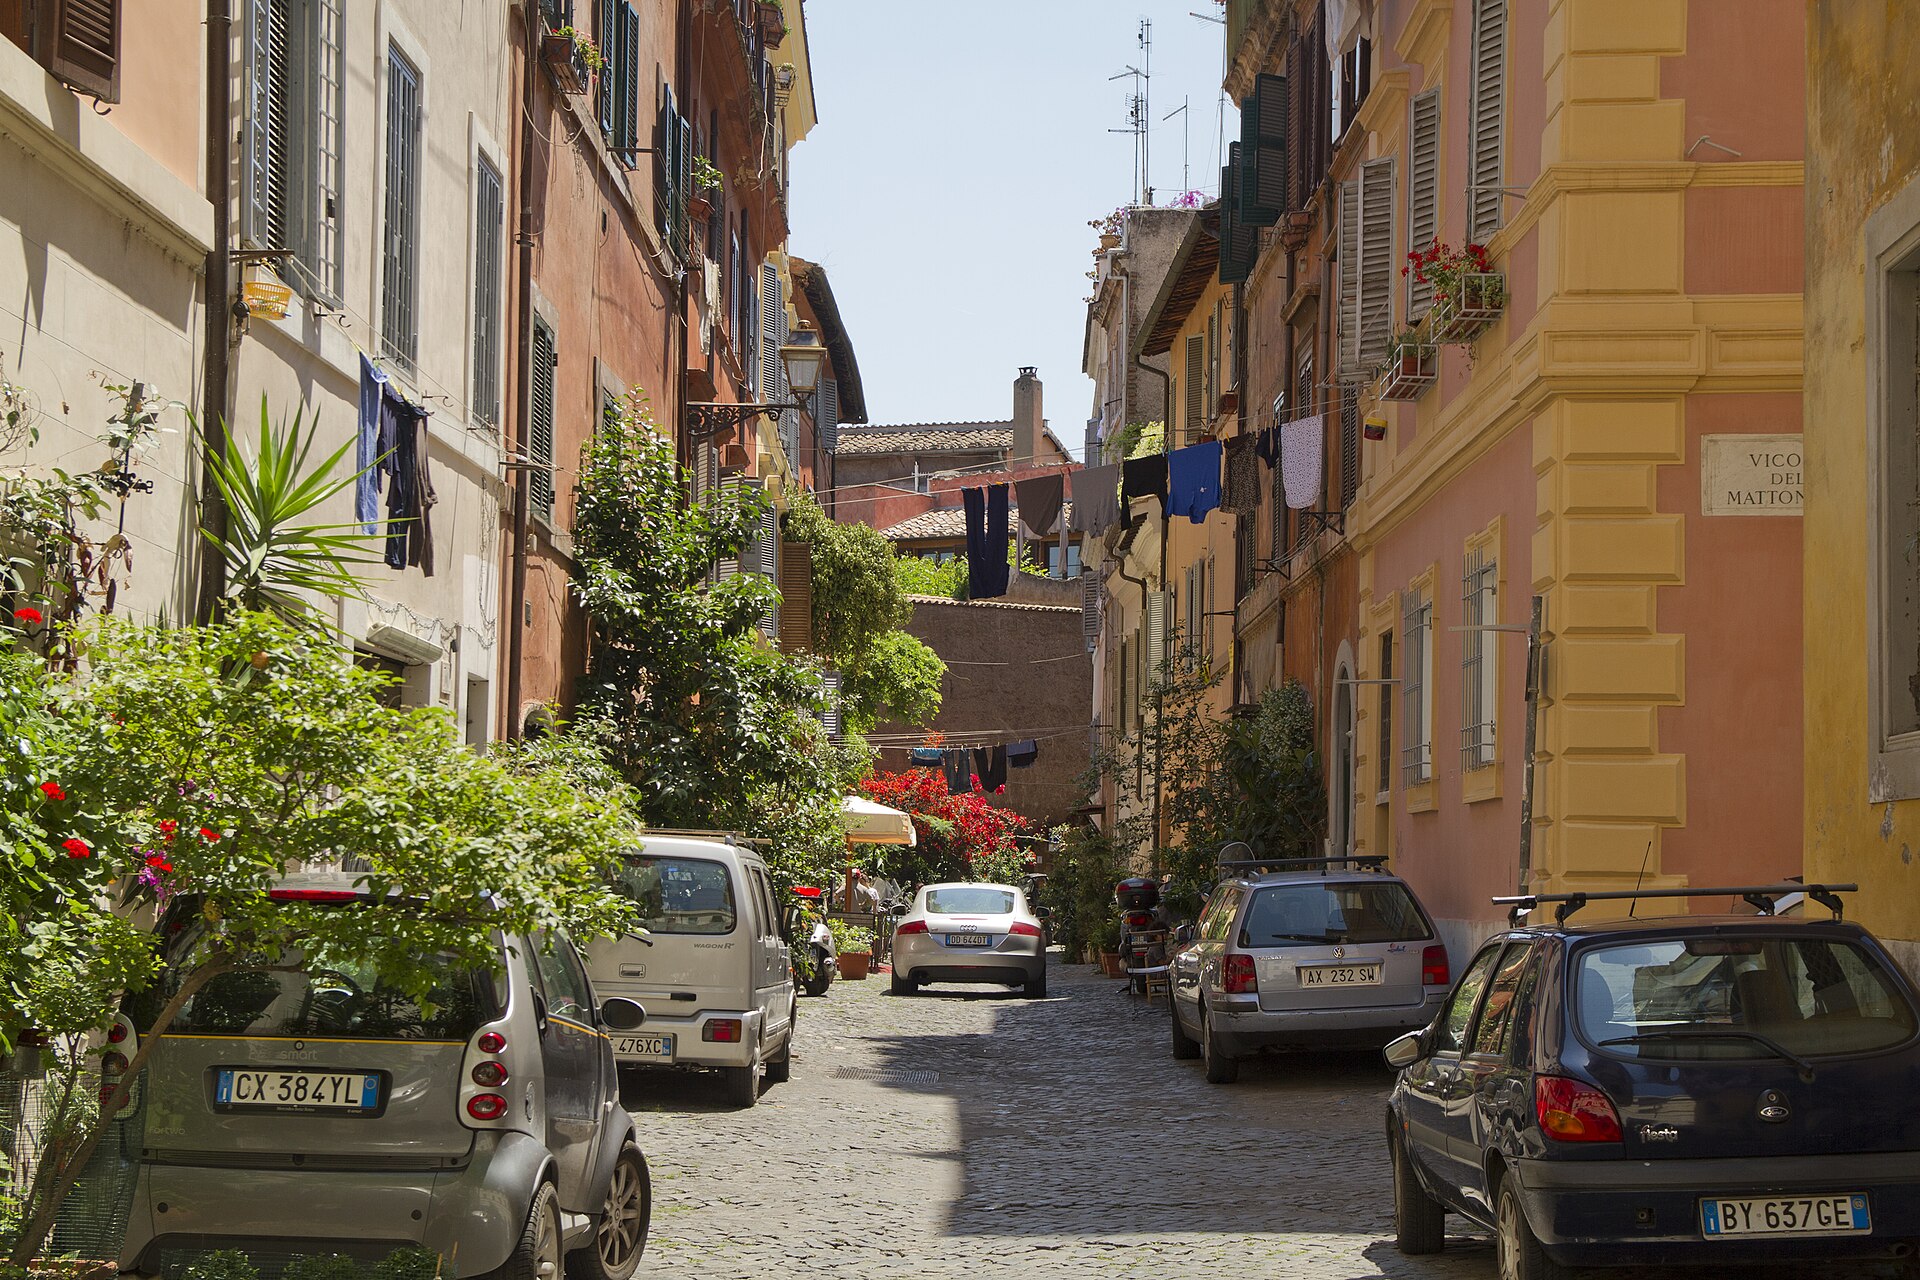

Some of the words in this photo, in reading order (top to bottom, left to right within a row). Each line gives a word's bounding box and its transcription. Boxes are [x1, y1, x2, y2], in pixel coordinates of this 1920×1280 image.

[1749, 453, 1801, 467] VICO
[1308, 970, 1322, 983] AX
[1331, 969, 1354, 982] 232
[1360, 967, 1375, 981] SW
[619, 1038, 661, 1053] 476XC
[236, 1073, 268, 1101] CX
[277, 1074, 358, 1104] 384YL
[1722, 1202, 1752, 1230] BY
[1764, 1199, 1850, 1229] 637GE
